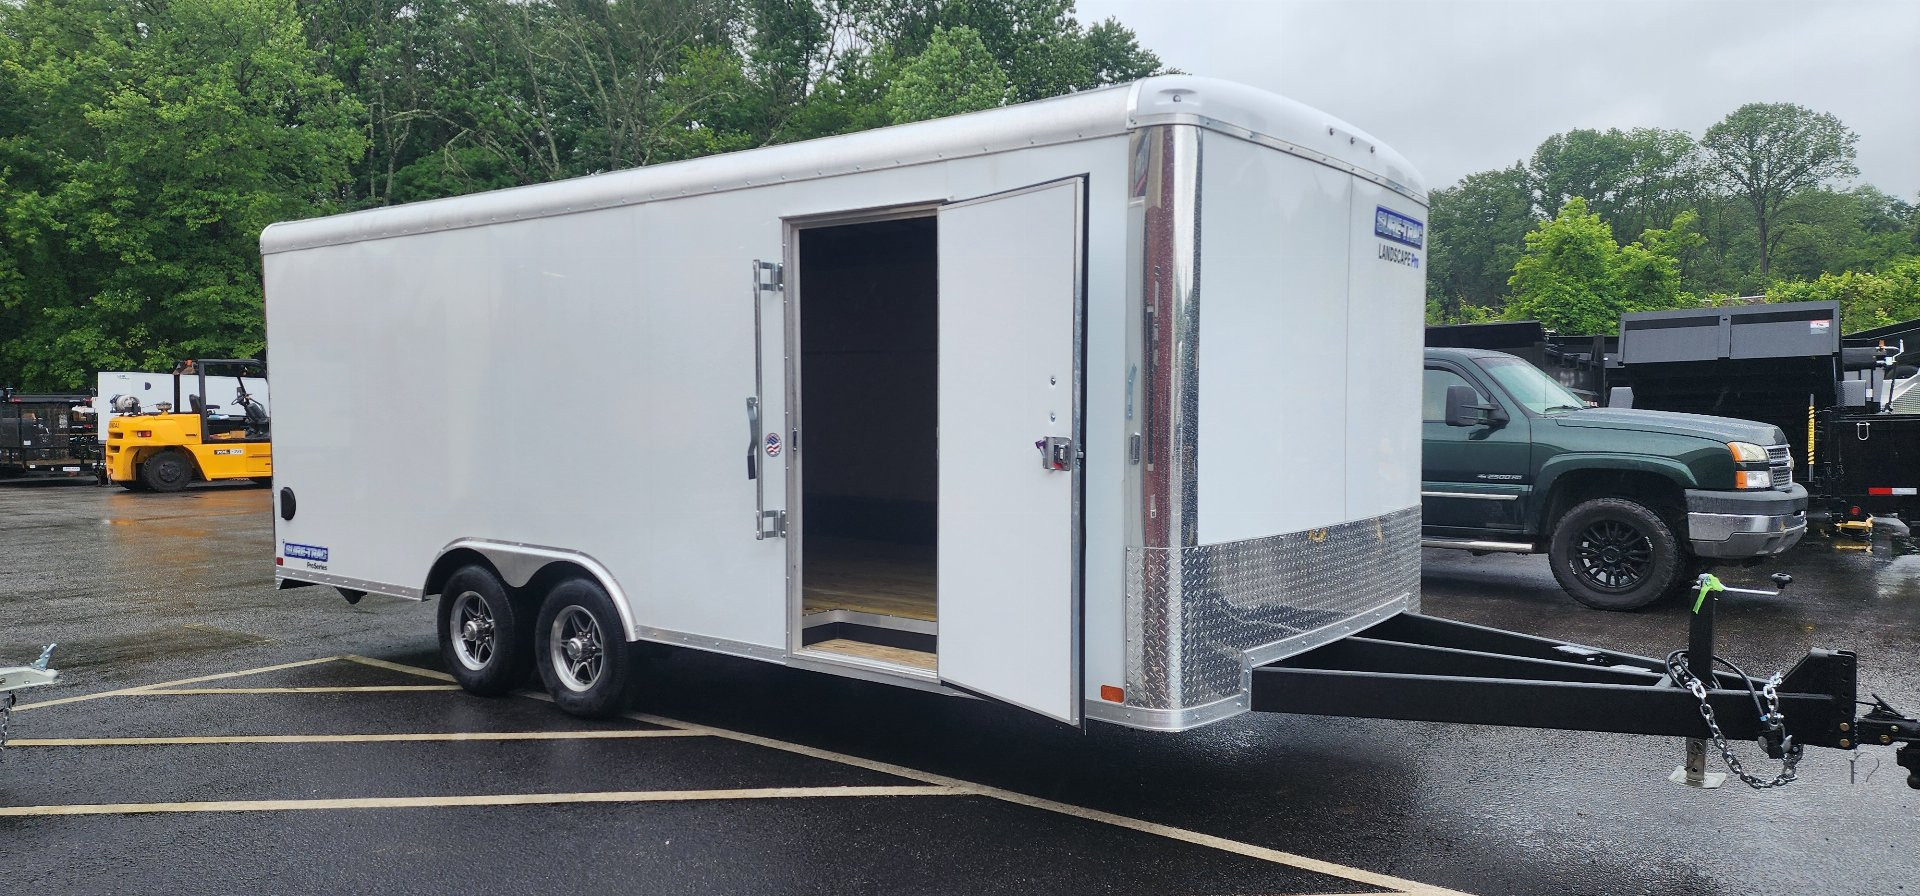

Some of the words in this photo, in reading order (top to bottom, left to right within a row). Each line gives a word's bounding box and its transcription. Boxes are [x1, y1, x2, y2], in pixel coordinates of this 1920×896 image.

[1376, 209, 1423, 246] SURE-TRAC
[1378, 242, 1411, 267] LANDSCAPE
[285, 544, 328, 561] SURE-TRAC
[306, 561, 328, 571] ProSeries
